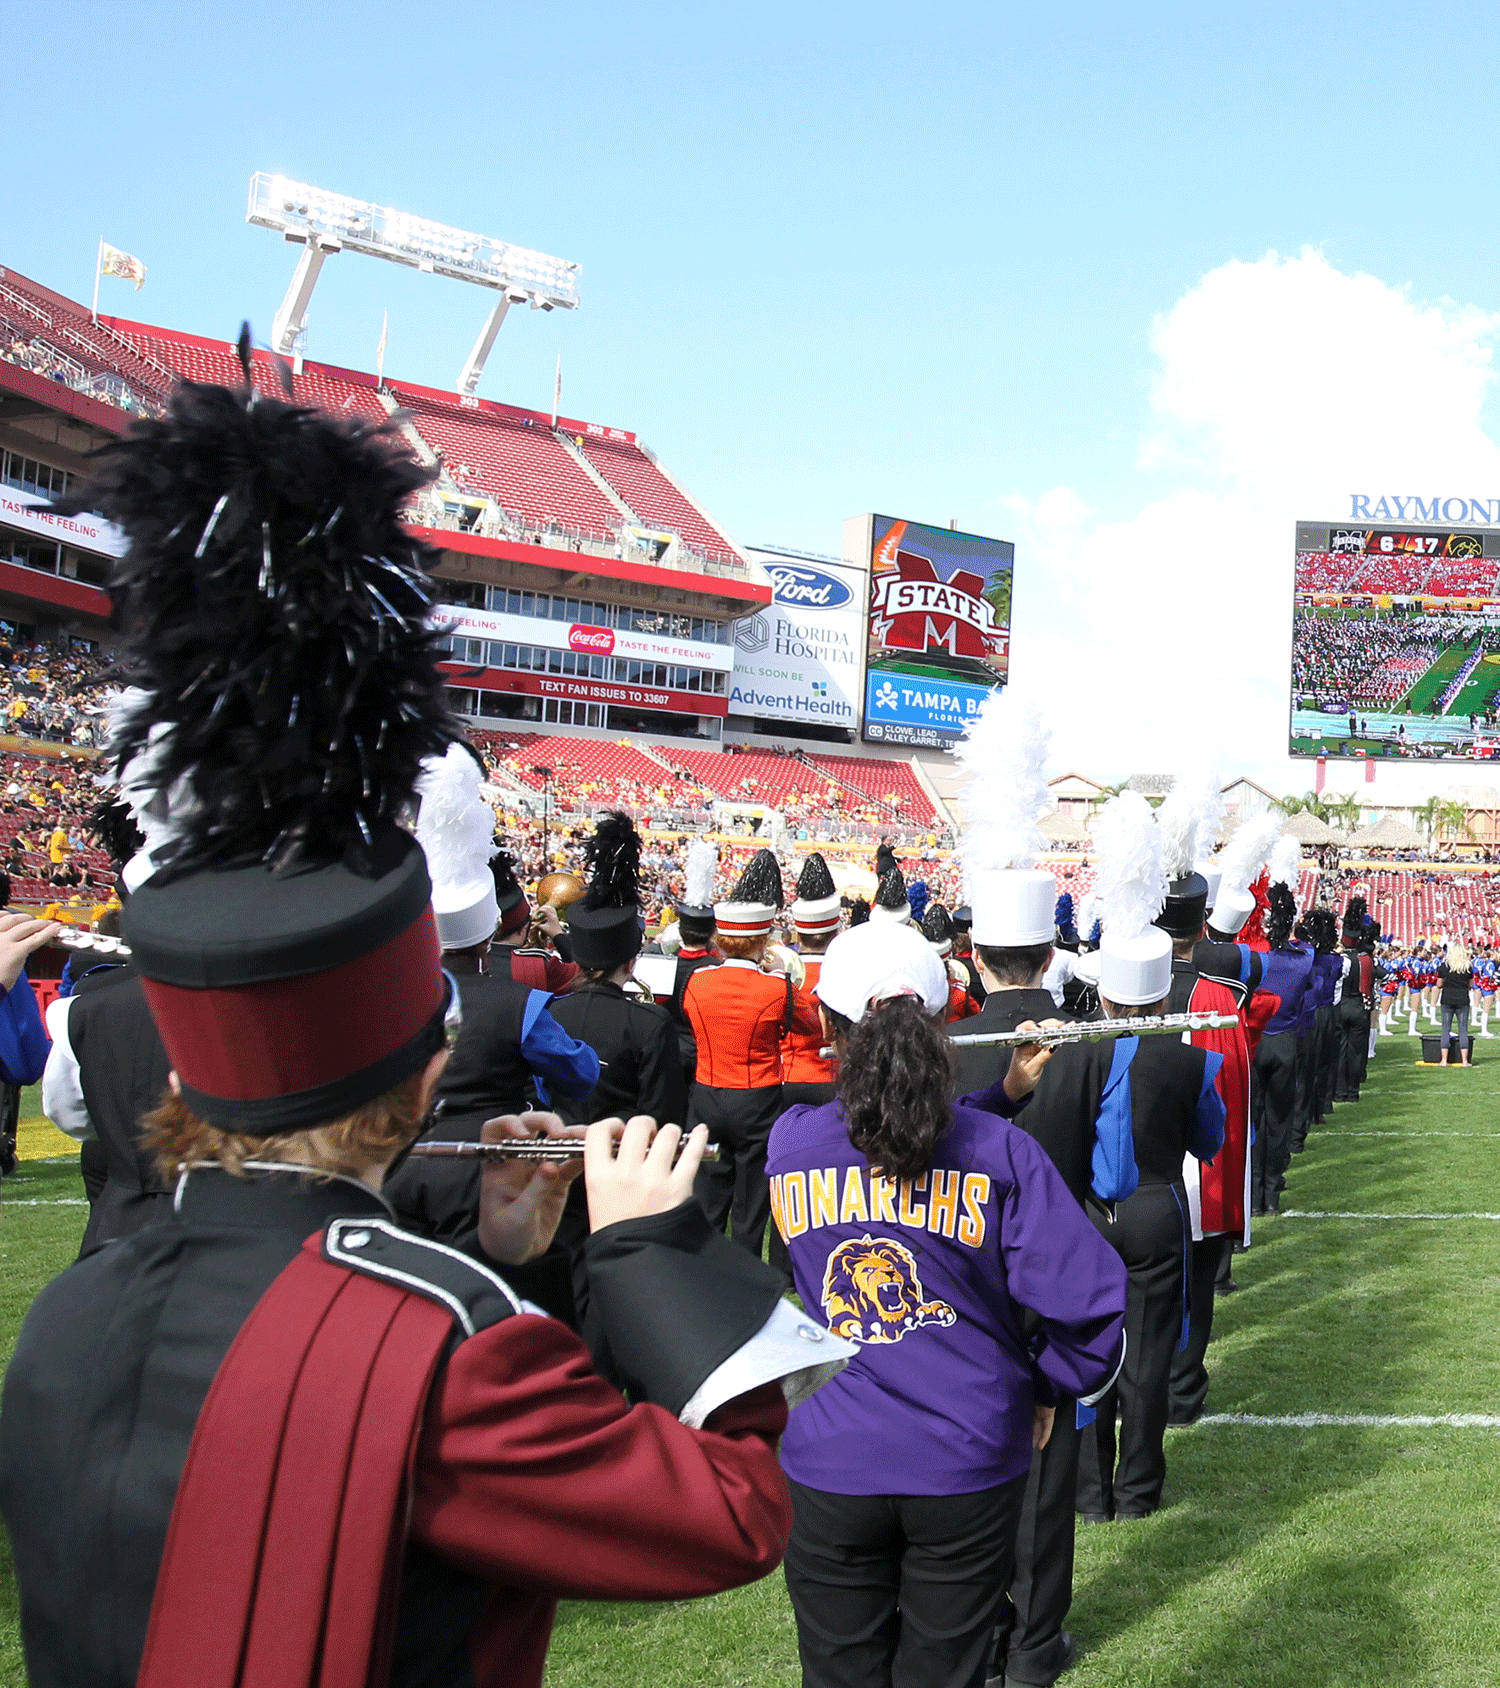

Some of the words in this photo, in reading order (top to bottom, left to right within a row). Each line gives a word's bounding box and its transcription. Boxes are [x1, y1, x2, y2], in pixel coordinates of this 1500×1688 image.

[460, 396, 479, 407] 303
[1, 499, 32, 518] TASTE
[36, 511, 55, 525] THE
[57, 518, 97, 538] FEELING
[1380, 536, 1394, 552] 6
[1414, 537, 1439, 553] 17
[770, 567, 833, 604] Ford
[898, 585, 981, 625] STATE
[451, 616, 497, 630] FEELING
[776, 619, 849, 646] FLORIDA
[570, 630, 613, 648] Coca-Cola
[620, 640, 649, 651] TASTE
[651, 644, 669, 655] THE
[672, 647, 711, 660] FEELING
[775, 637, 858, 665] HOSPITAL
[733, 664, 755, 675] WILL
[758, 667, 788, 680] SOON
[791, 672, 804, 681] BE
[539, 680, 566, 693] TEXT
[568, 683, 588, 695] FAN
[590, 686, 626, 700] ISSUES
[629, 689, 642, 701] TO
[644, 692, 669, 705] 33607
[902, 689, 961, 713] TAMPA
[966, 698, 986, 715] BA
[884, 733, 909, 743] ALLEY
[945, 740, 955, 748] TE
[917, 729, 937, 738] LEAD
[769, 1166, 990, 1248] MONARCHS
